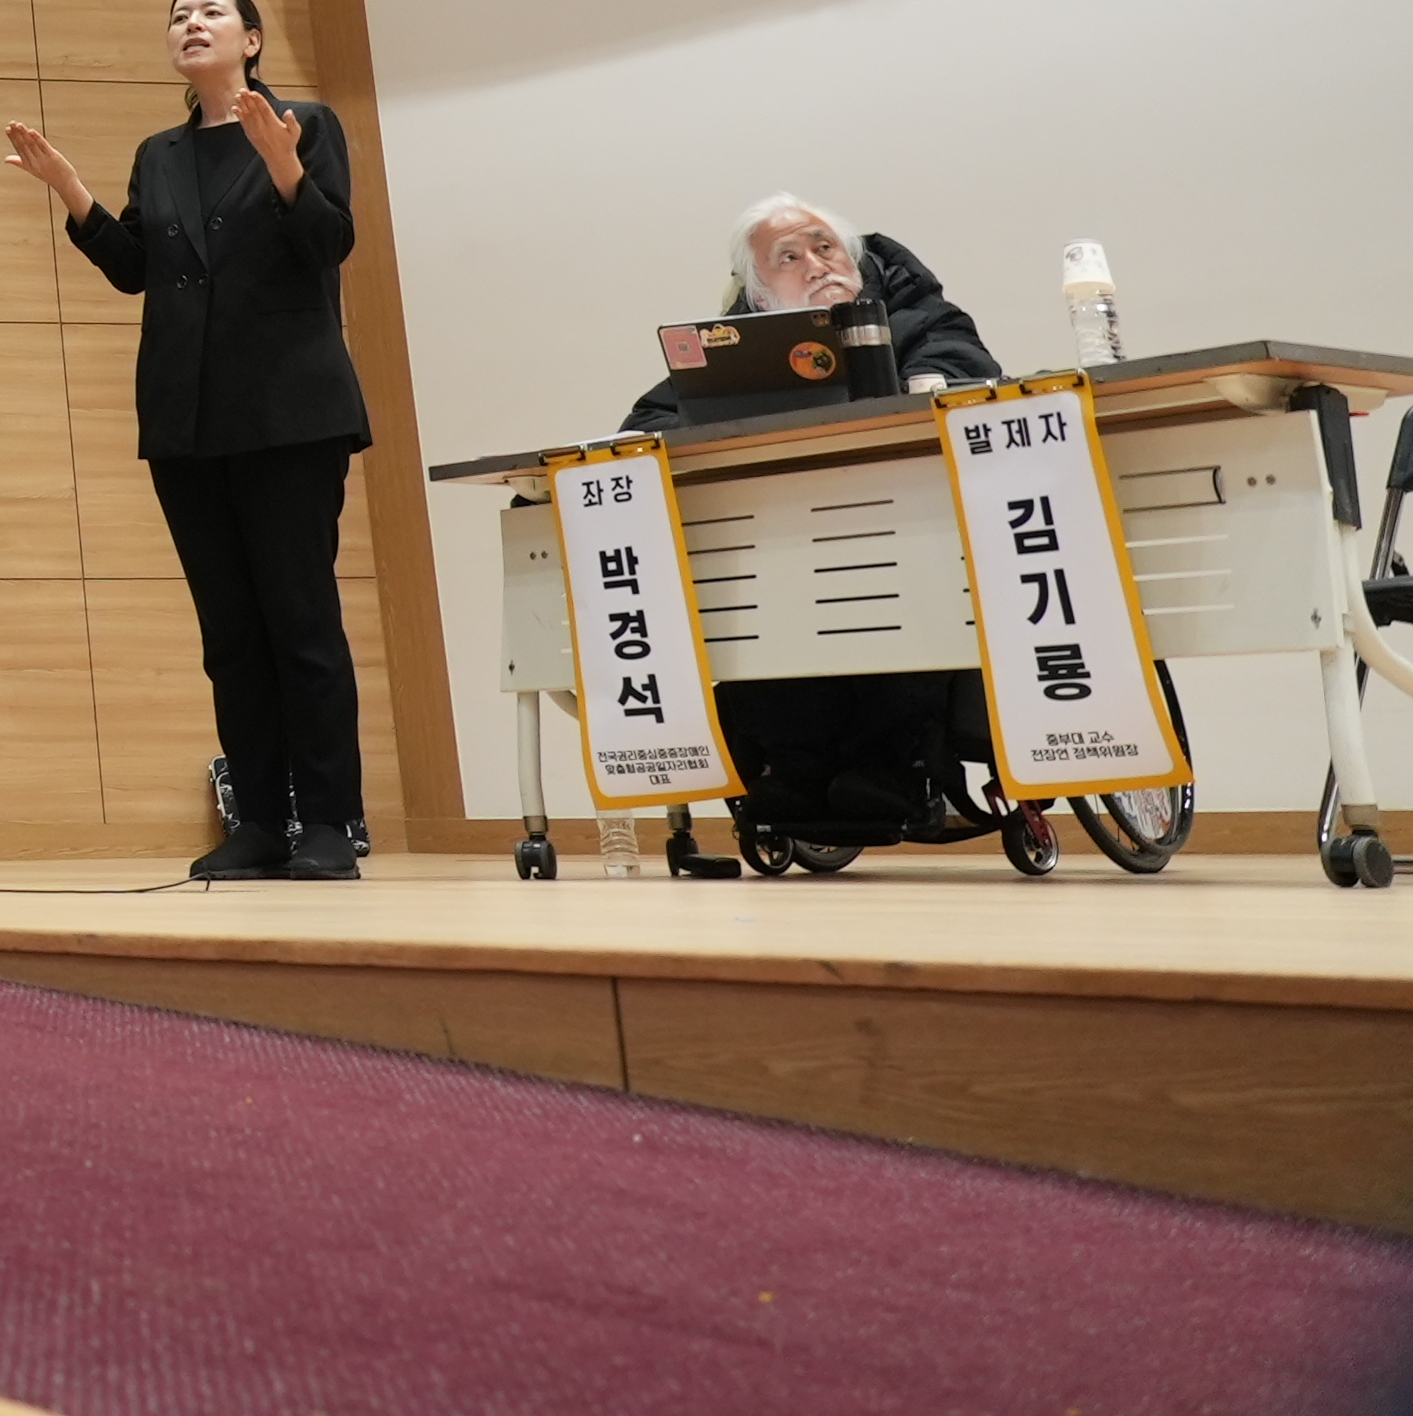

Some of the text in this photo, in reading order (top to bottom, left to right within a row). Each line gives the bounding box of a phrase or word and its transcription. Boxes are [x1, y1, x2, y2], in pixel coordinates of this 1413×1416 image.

[963, 410, 1069, 456] 발제자
[580, 473, 635, 508] 좌장
[1006, 494, 1094, 702] 김기룡
[598, 545, 666, 725] 박경석
[1087, 730, 1115, 744] 교수
[648, 773, 672, 786] 대표
